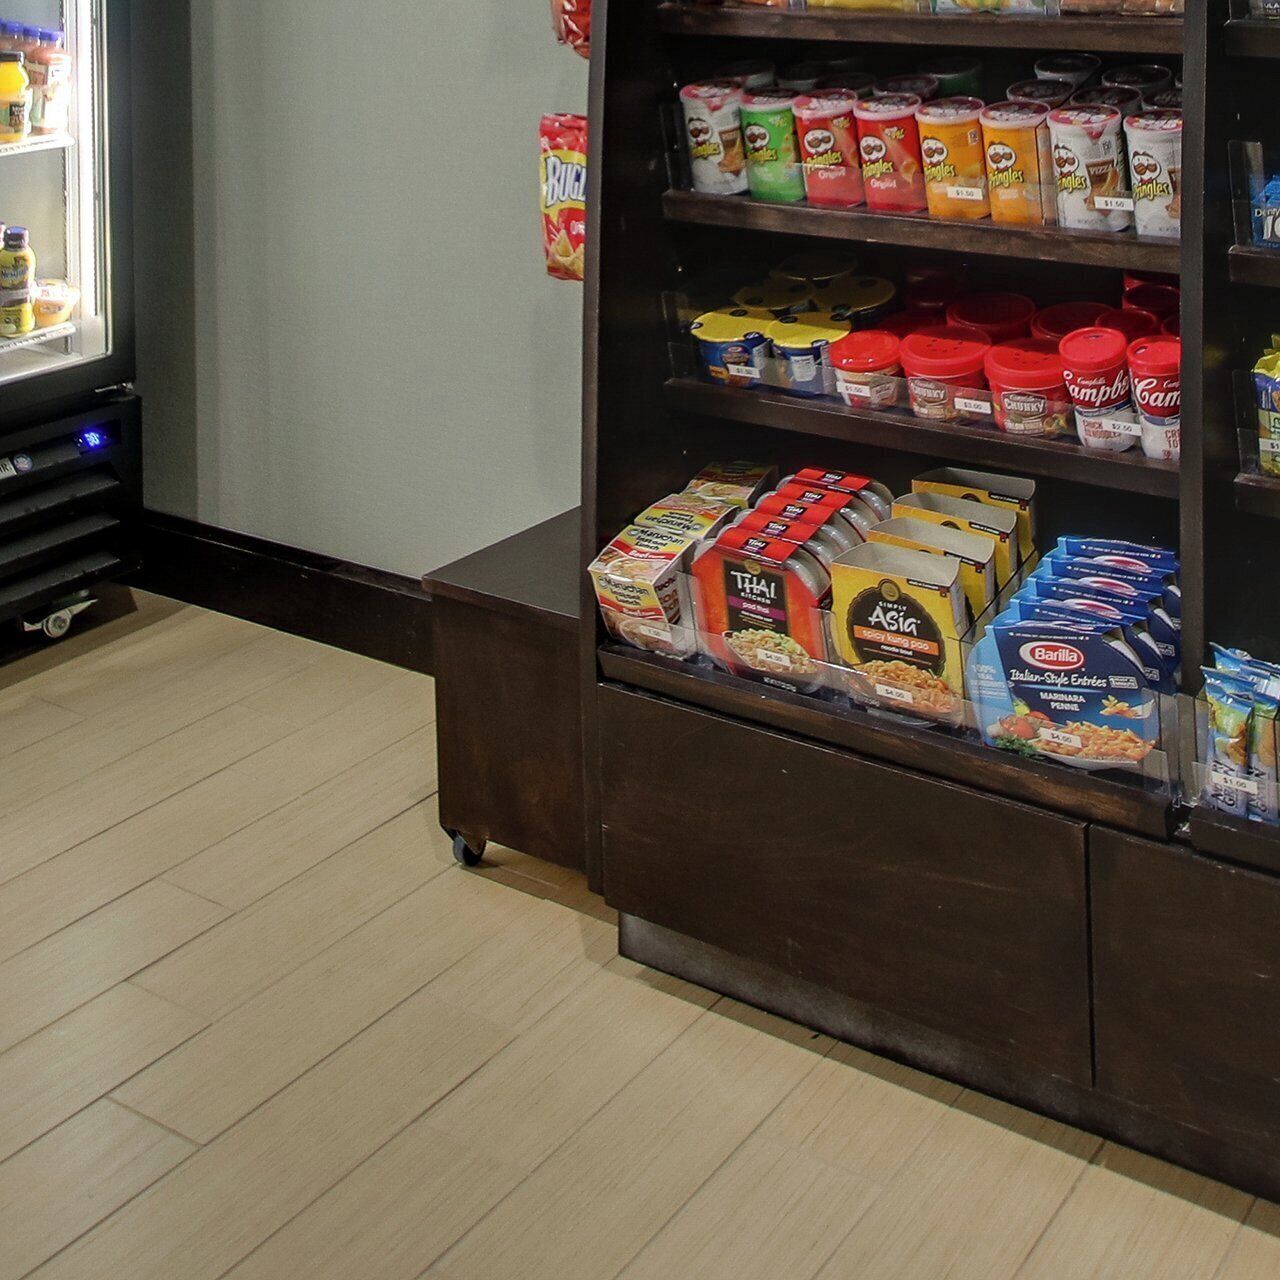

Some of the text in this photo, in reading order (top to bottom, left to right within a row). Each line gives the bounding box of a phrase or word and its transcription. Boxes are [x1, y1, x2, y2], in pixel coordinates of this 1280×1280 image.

[805, 150, 842, 174] Pringles
[989, 167, 1025, 189] Pringles
[1132, 178, 1173, 202] Pringles
[639, 529, 684, 545] Maruchan
[730, 570, 776, 599] THAI
[741, 592, 771, 604] KITCHEN
[878, 601, 907, 612] SIMPLY
[868, 605, 919, 636] Asia
[862, 628, 930, 652] spicy kung pao
[1034, 648, 1078, 662] Barilla
[1010, 669, 1069, 688] Italian-Style
[1071, 675, 1107, 687] Entrées
[1040, 692, 1086, 703] MARINARA
[1051, 702, 1080, 711] PENNE
[1223, 777, 1246, 789] $1.00
